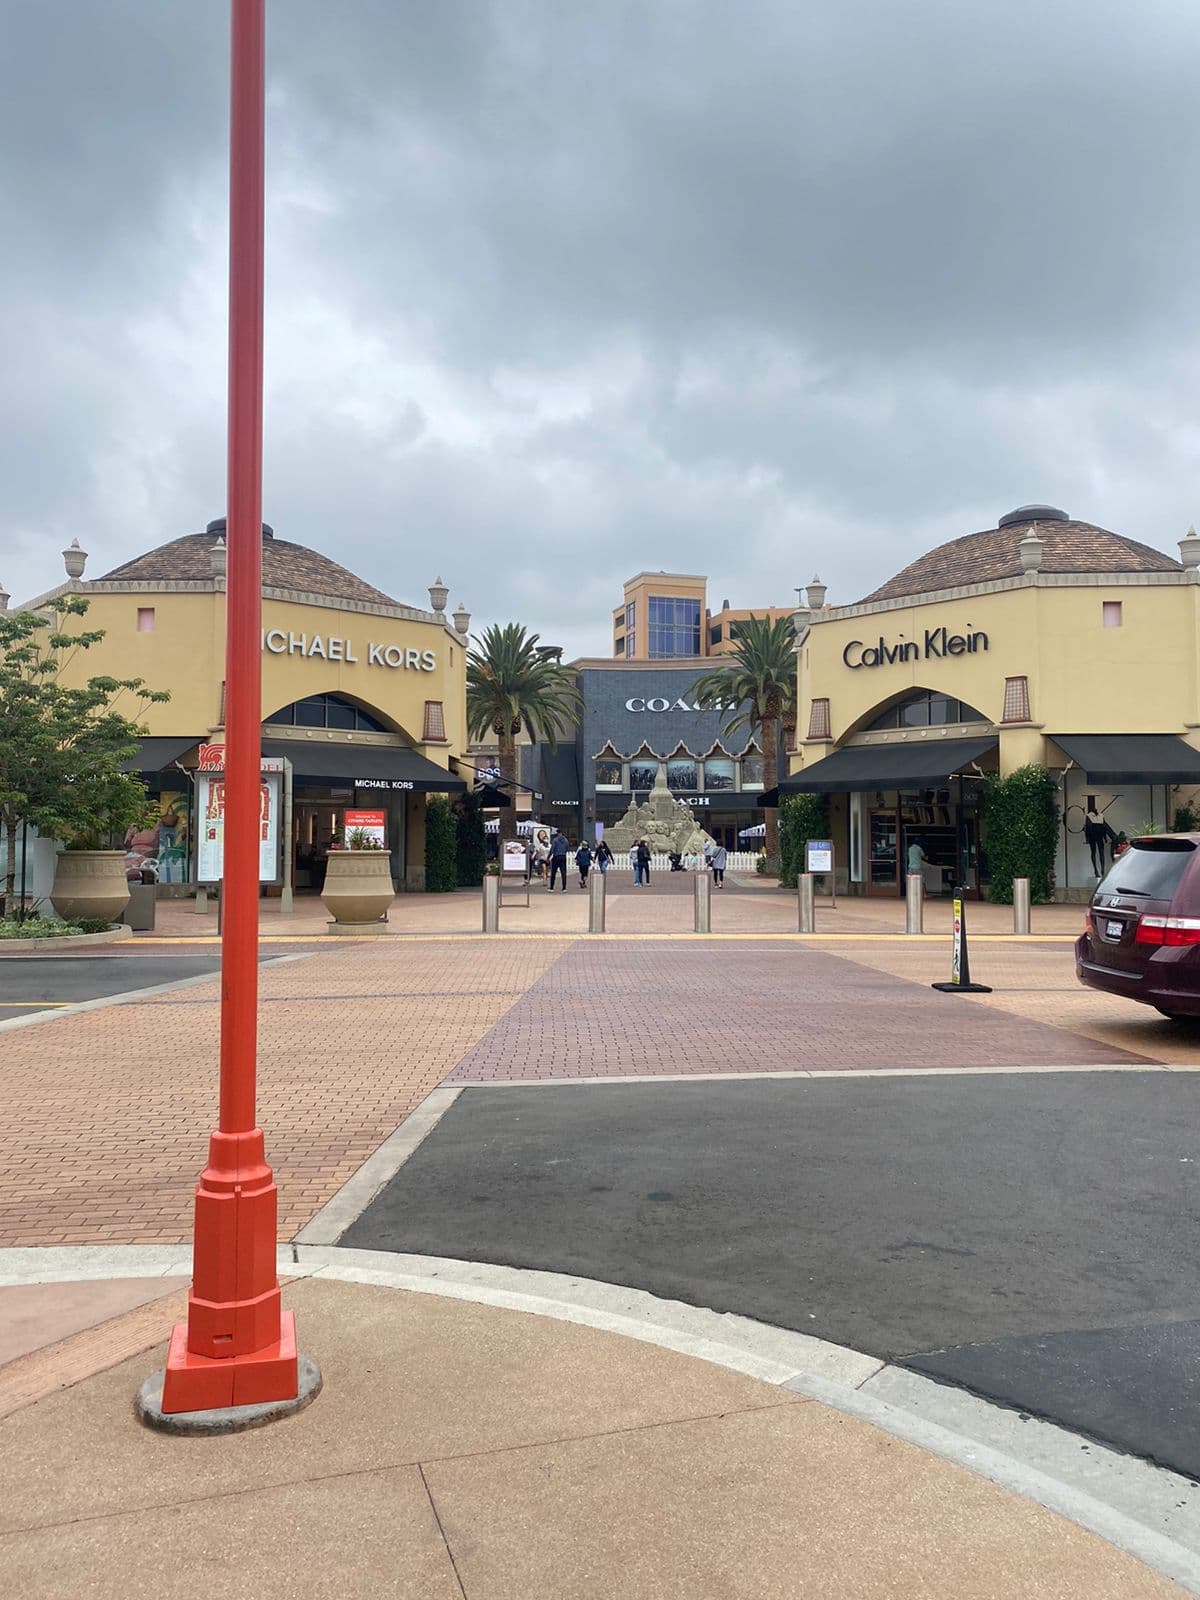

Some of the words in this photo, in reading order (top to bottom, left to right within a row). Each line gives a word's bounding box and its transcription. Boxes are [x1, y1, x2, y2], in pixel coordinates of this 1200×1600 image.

[261, 628, 358, 663] ICHAEL
[368, 642, 437, 672] KORS
[843, 633, 919, 669] Calvin
[924, 623, 989, 659] Klein
[354, 779, 390, 789] MICHAEL
[392, 781, 414, 790] KORS
[672, 797, 710, 806] ACH
